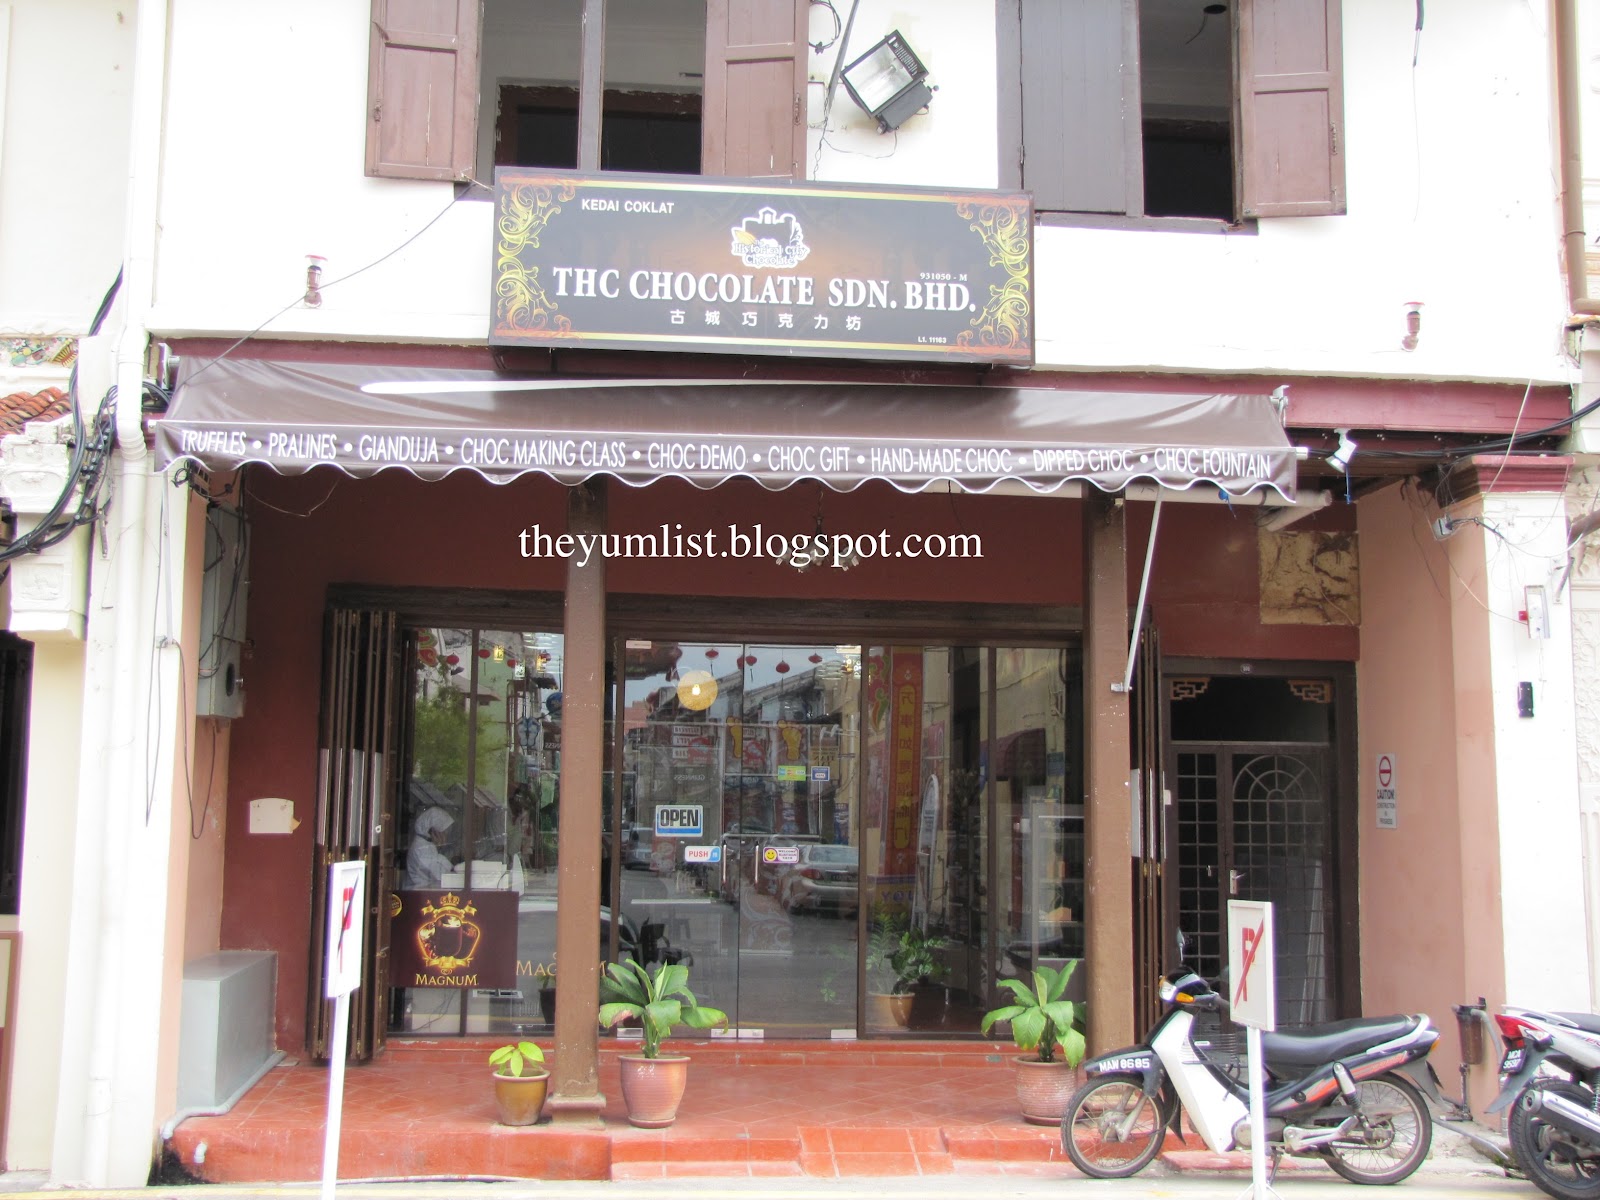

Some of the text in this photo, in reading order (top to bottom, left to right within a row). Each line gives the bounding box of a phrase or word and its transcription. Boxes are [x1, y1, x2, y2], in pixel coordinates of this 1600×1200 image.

[581, 198, 675, 214] KEDAI COKLAT
[919, 272, 951, 281] 931050
[552, 267, 976, 313] THC CHOCOLATE SDN. BHD.
[181, 429, 1271, 479] TRUFFLES PRALINES GIANDUJA CHOC MAKING CLASS CHOC DEMO CHOC GIFT HAND-MADE CHOC DIPPED CHOC CHOC FOUNTAIN
[660, 809, 698, 826] OPEN
[415, 973, 478, 986] MAGNUM
[1099, 1057, 1151, 1072] MAW 8685
